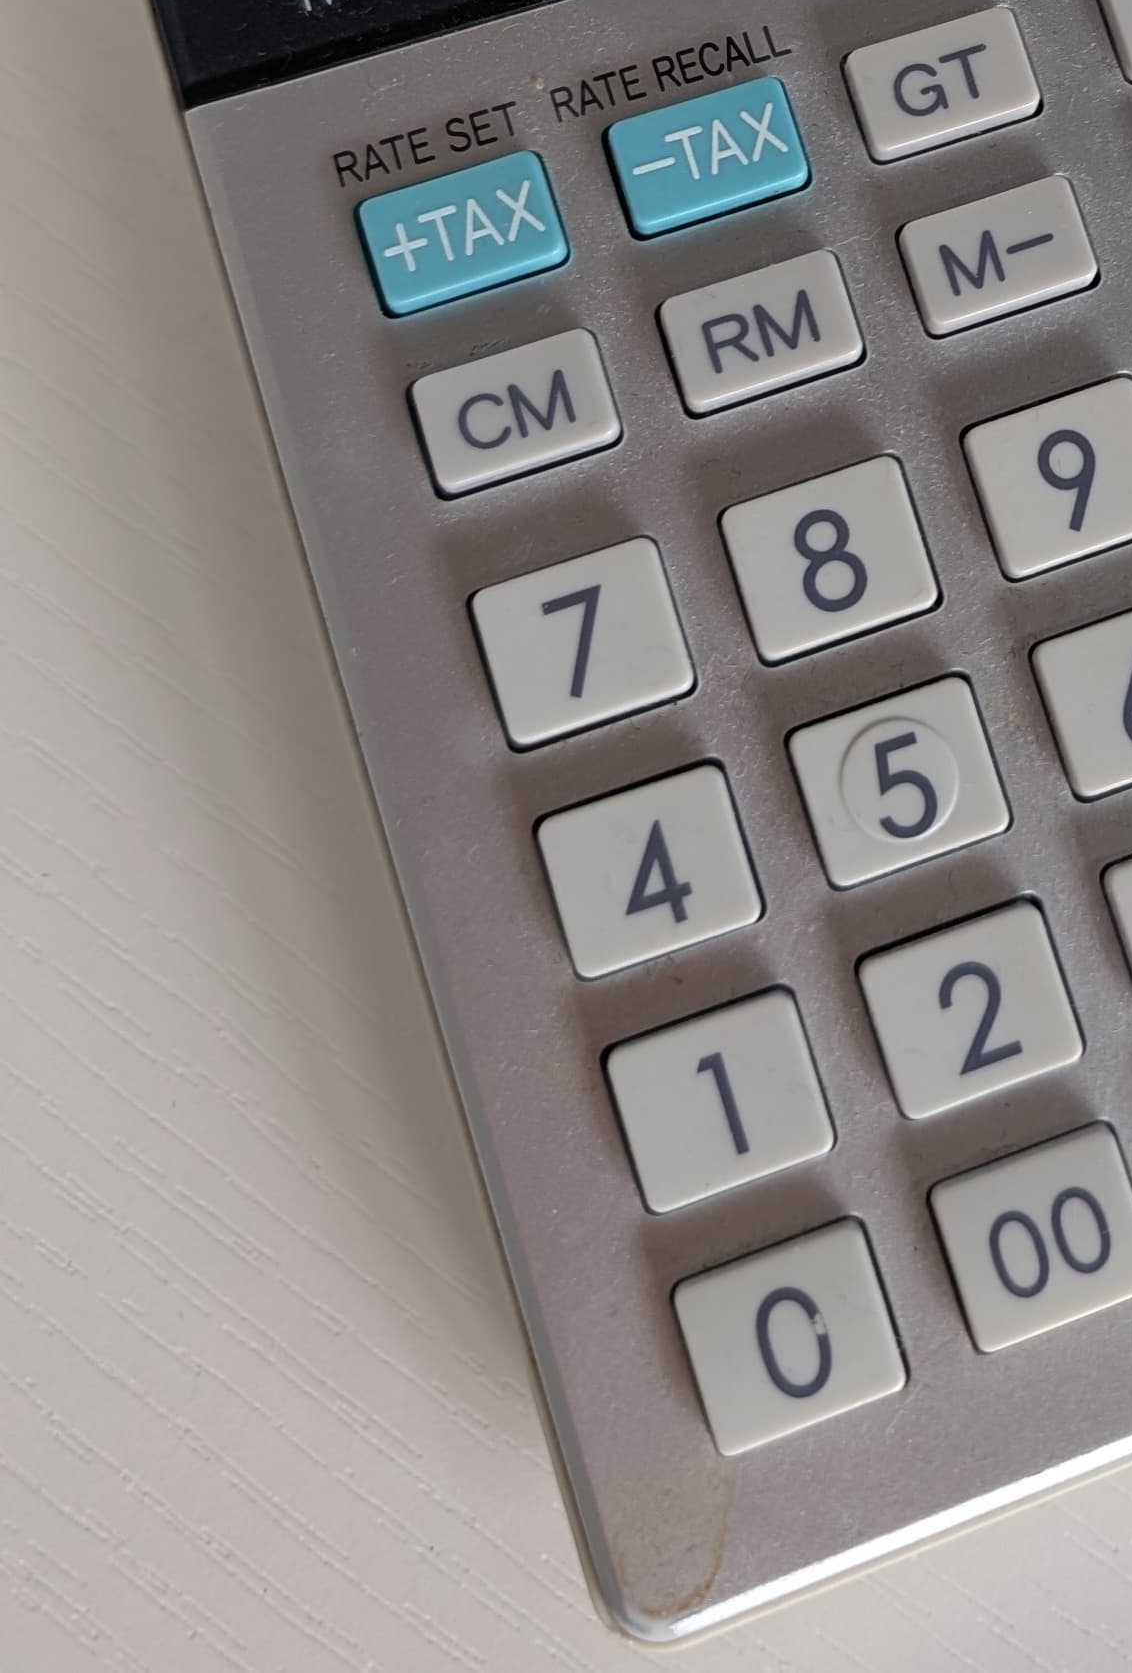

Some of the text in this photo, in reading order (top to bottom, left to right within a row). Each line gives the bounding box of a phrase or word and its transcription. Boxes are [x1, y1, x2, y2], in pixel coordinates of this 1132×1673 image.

[550, 26, 792, 122] RATE RECALL
[893, 43, 988, 117] GT
[333, 102, 518, 188] RATE SET
[384, 179, 546, 272] +TAX
[703, 290, 821, 375] RM
[457, 368, 577, 450] CM
[1037, 428, 1097, 532] 9
[792, 508, 869, 614] 8
[541, 584, 603, 698] 7
[874, 731, 940, 841] 5
[624, 818, 694, 923] 4
[938, 960, 1023, 1075] 2
[695, 1052, 750, 1155] 1
[987, 1185, 1113, 1299] 00
[755, 1285, 834, 1399] 0
